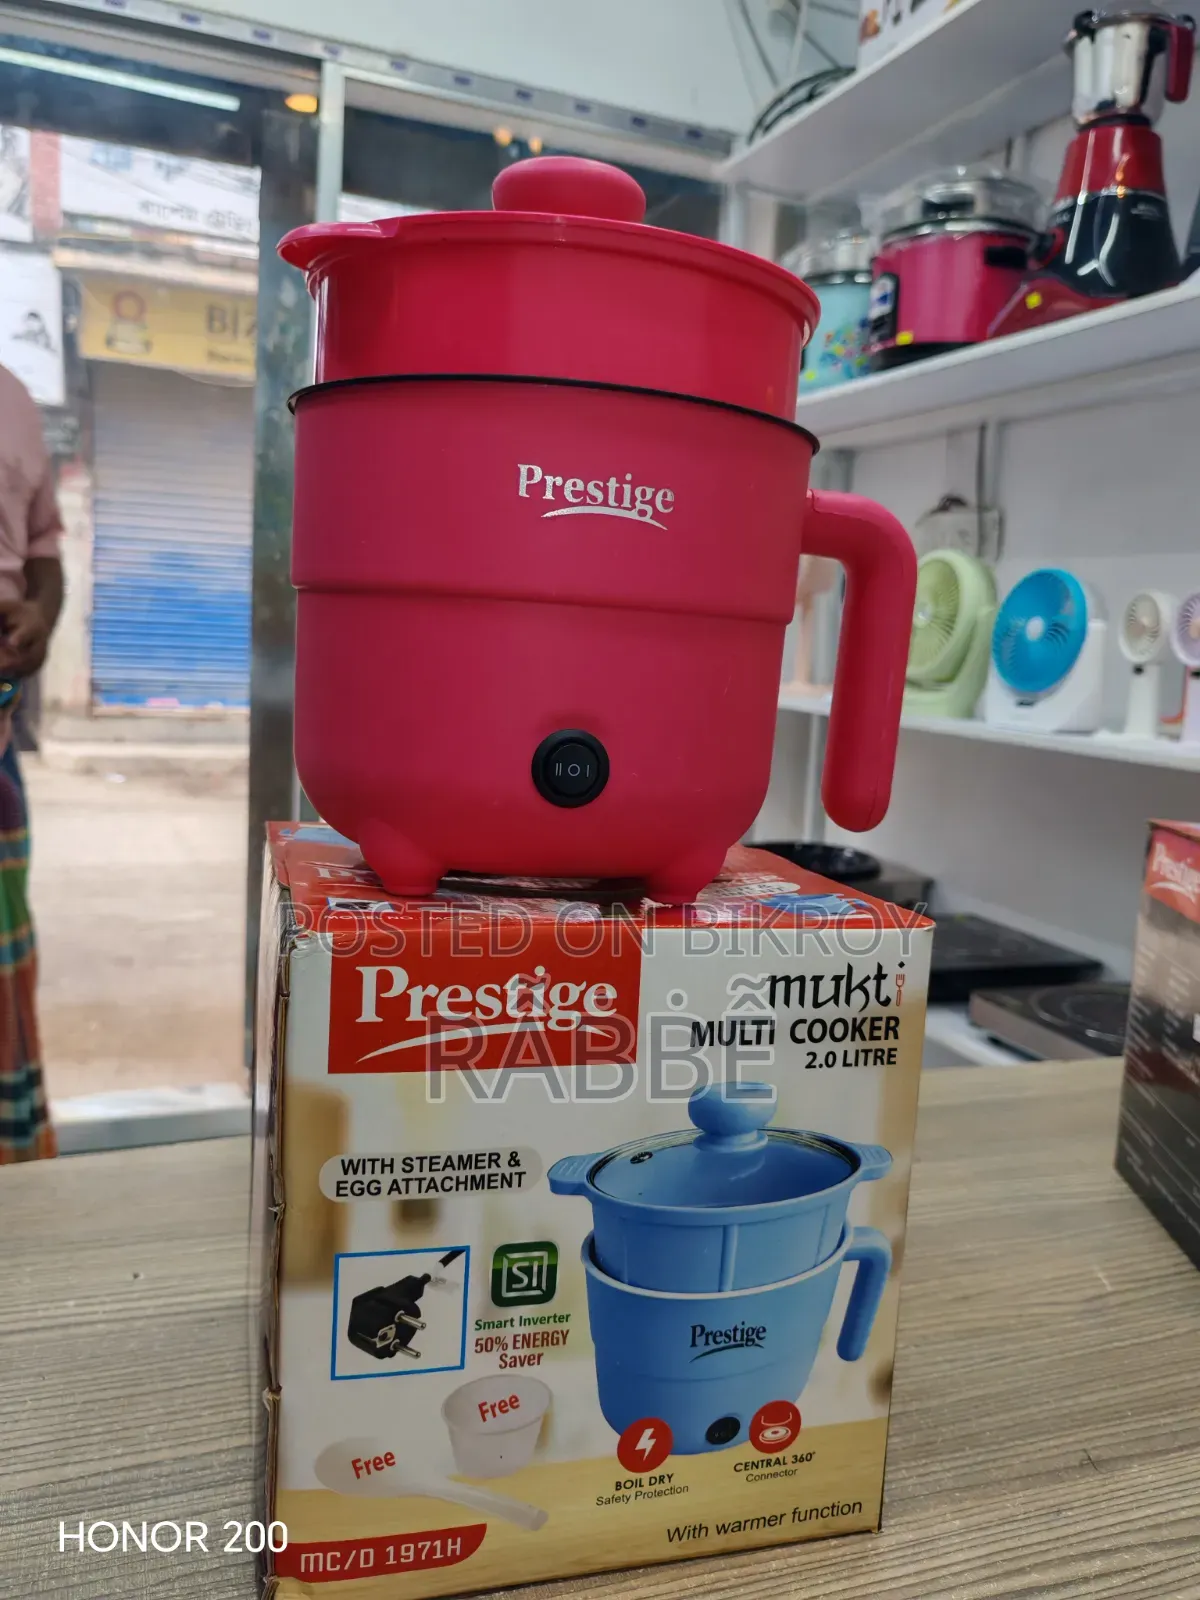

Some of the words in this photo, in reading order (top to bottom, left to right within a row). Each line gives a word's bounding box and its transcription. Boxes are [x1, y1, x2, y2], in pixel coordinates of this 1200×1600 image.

[517, 463, 675, 519] Prestige
[355, 965, 617, 1031] Prestige
[690, 1018, 775, 1047] MULTI
[789, 1016, 900, 1044] COOKER
[804, 1050, 837, 1069] 2.0
[842, 1048, 898, 1068] LITRE
[340, 1157, 395, 1176] WITH
[401, 1151, 502, 1174] STEAMER
[507, 1150, 522, 1168] &
[335, 1179, 382, 1197] EGG
[387, 1171, 527, 1196] ATTACHMENT
[474, 1316, 515, 1331] Smart
[519, 1312, 572, 1327] Inverter
[690, 1321, 767, 1347] Prestige
[474, 1336, 509, 1353] 50%
[512, 1329, 570, 1350] ENERGY
[498, 1352, 544, 1369] Saver
[478, 1393, 521, 1423] Free
[351, 1449, 397, 1480] Free
[733, 1455, 788, 1473] CENTRAL
[745, 1467, 799, 1483] Connector
[614, 1476, 645, 1491] BOIL
[648, 1473, 675, 1486] DRY
[595, 1492, 631, 1507] Safety
[634, 1484, 690, 1501] Protection
[666, 1522, 709, 1543] With
[715, 1510, 787, 1535] warmer
[791, 1500, 863, 1523] function
[384, 1537, 462, 1567] 1971H
